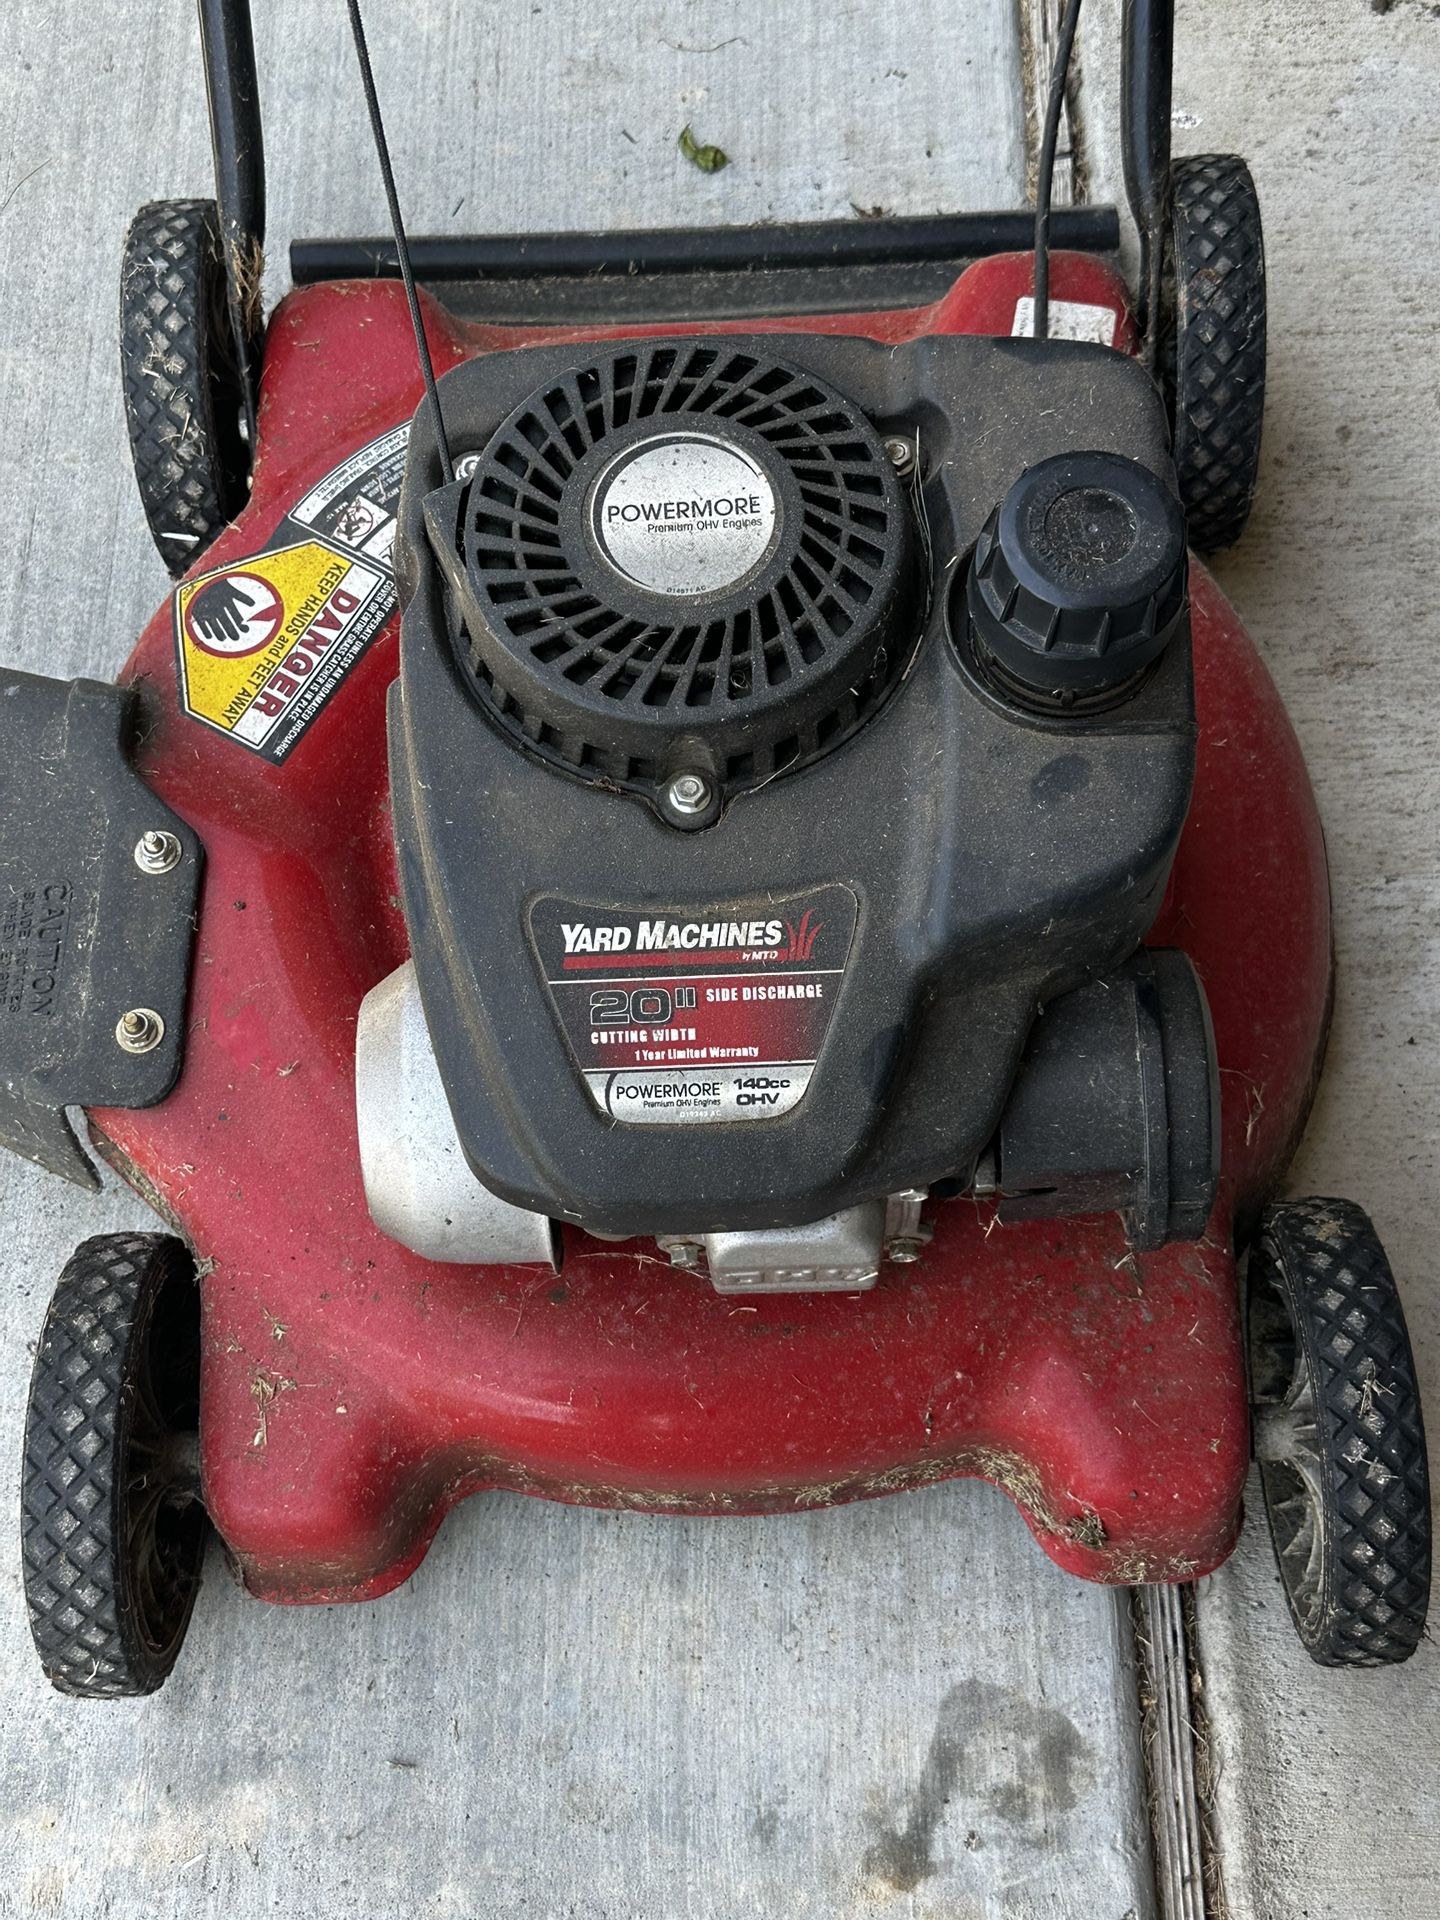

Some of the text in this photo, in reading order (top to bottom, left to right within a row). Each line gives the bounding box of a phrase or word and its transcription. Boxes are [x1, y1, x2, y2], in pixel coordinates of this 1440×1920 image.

[608, 496, 760, 523] POWERMORE
[648, 518, 763, 533] Premium OHV Engines
[374, 579, 395, 603] COVER
[366, 600, 379, 614] OR
[351, 610, 372, 635] ENTIRE
[357, 609, 385, 643] OPERATE
[220, 562, 345, 723] KEEP HANDS and FEET AWAY
[251, 587, 362, 719] DANGER
[335, 632, 356, 656] GRASS
[339, 639, 363, 668] UNLESS
[315, 652, 341, 684] CATCHER
[331, 666, 344, 679] AN
[300, 676, 336, 721] UNDAMAGED
[303, 689, 314, 700] IN
[309, 681, 320, 692] IS
[273, 718, 305, 757] DISCHARGE
[560, 920, 782, 953] YARD MACHINES
[28, 883, 67, 1017] CAUTION
[752, 950, 778, 960] MTD
[590, 984, 823, 1025] 20" SIDE DISCHARGE
[591, 1028, 696, 1044] CUTTING WIDTH
[635, 1046, 759, 1061] 1 Year Limited Warranty
[616, 1082, 721, 1100] POWERMORE
[733, 1078, 790, 1090] 140cc
[643, 1100, 674, 1108] Premium
[693, 1098, 721, 1107] Engines
[736, 1093, 780, 1106] OHV
